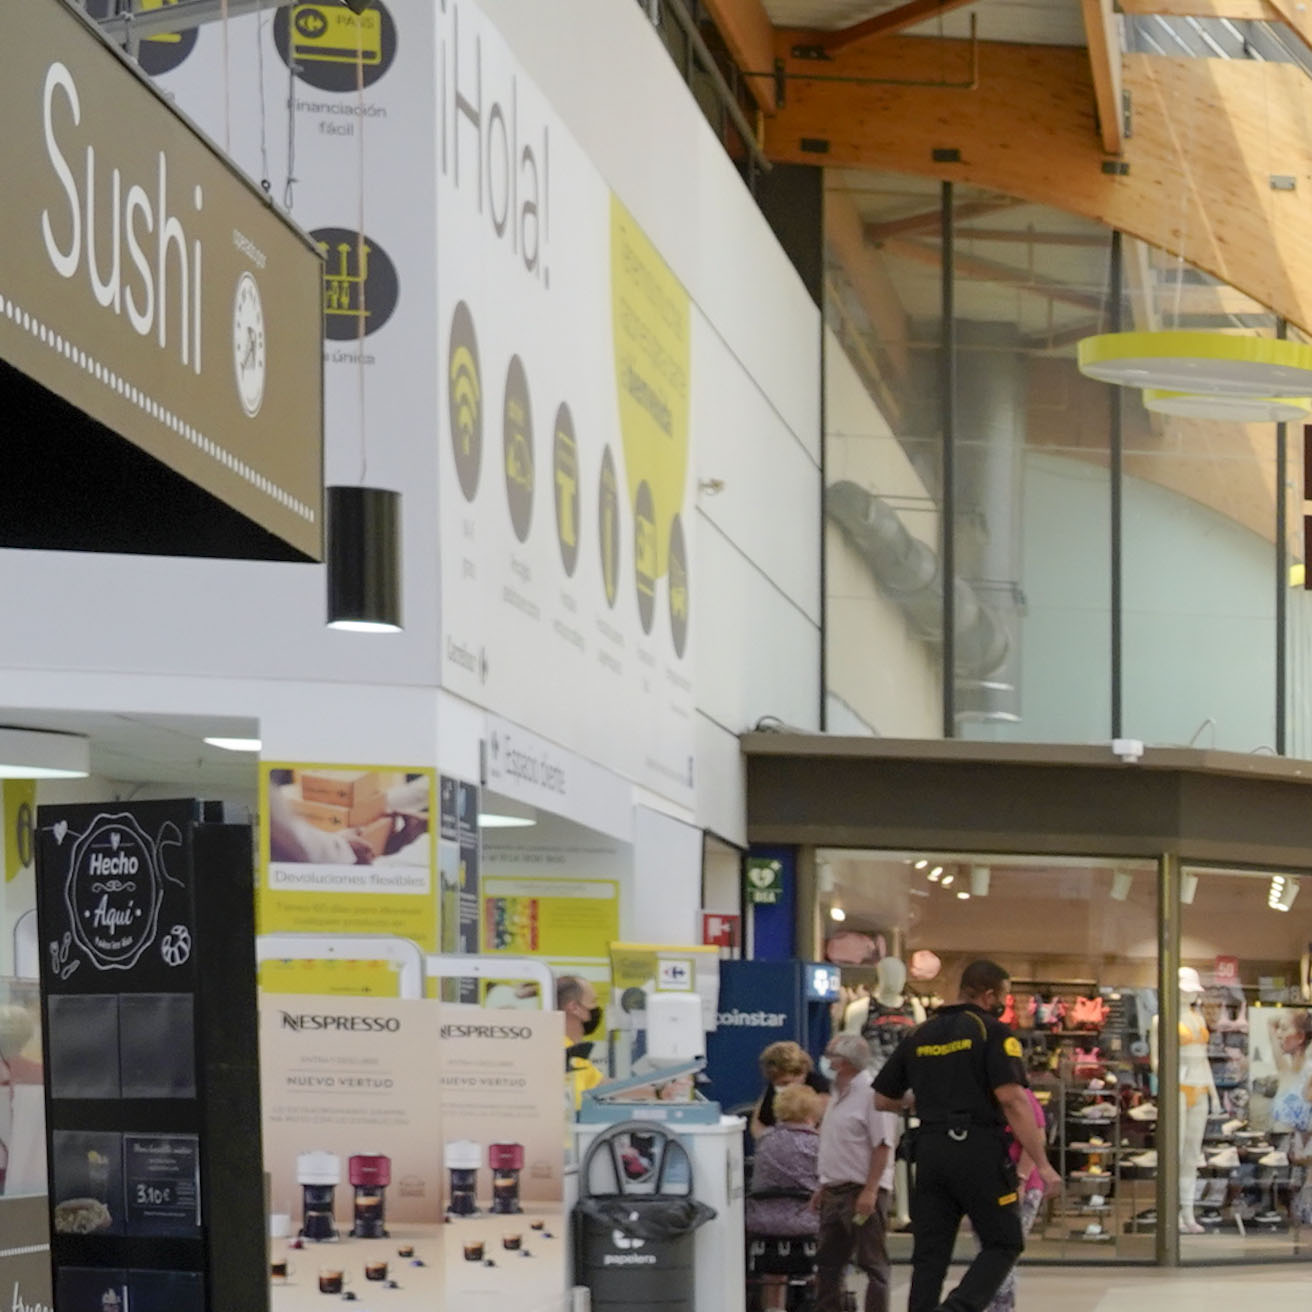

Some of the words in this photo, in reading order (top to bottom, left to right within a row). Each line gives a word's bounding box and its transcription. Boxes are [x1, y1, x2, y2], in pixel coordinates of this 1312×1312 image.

[318, 121, 355, 138] fácil
[41, 60, 204, 375] Sushi
[89, 850, 139, 877] Hecho
[275, 870, 365, 887] Devoluciones
[93, 893, 135, 936] Aquí
[1218, 963, 1235, 979] 50
[279, 1010, 401, 1032] NESPRESSO
[286, 1075, 335, 1088] NUEVO
[339, 1076, 394, 1089] VERTUO
[603, 1252, 657, 1267] papelera
